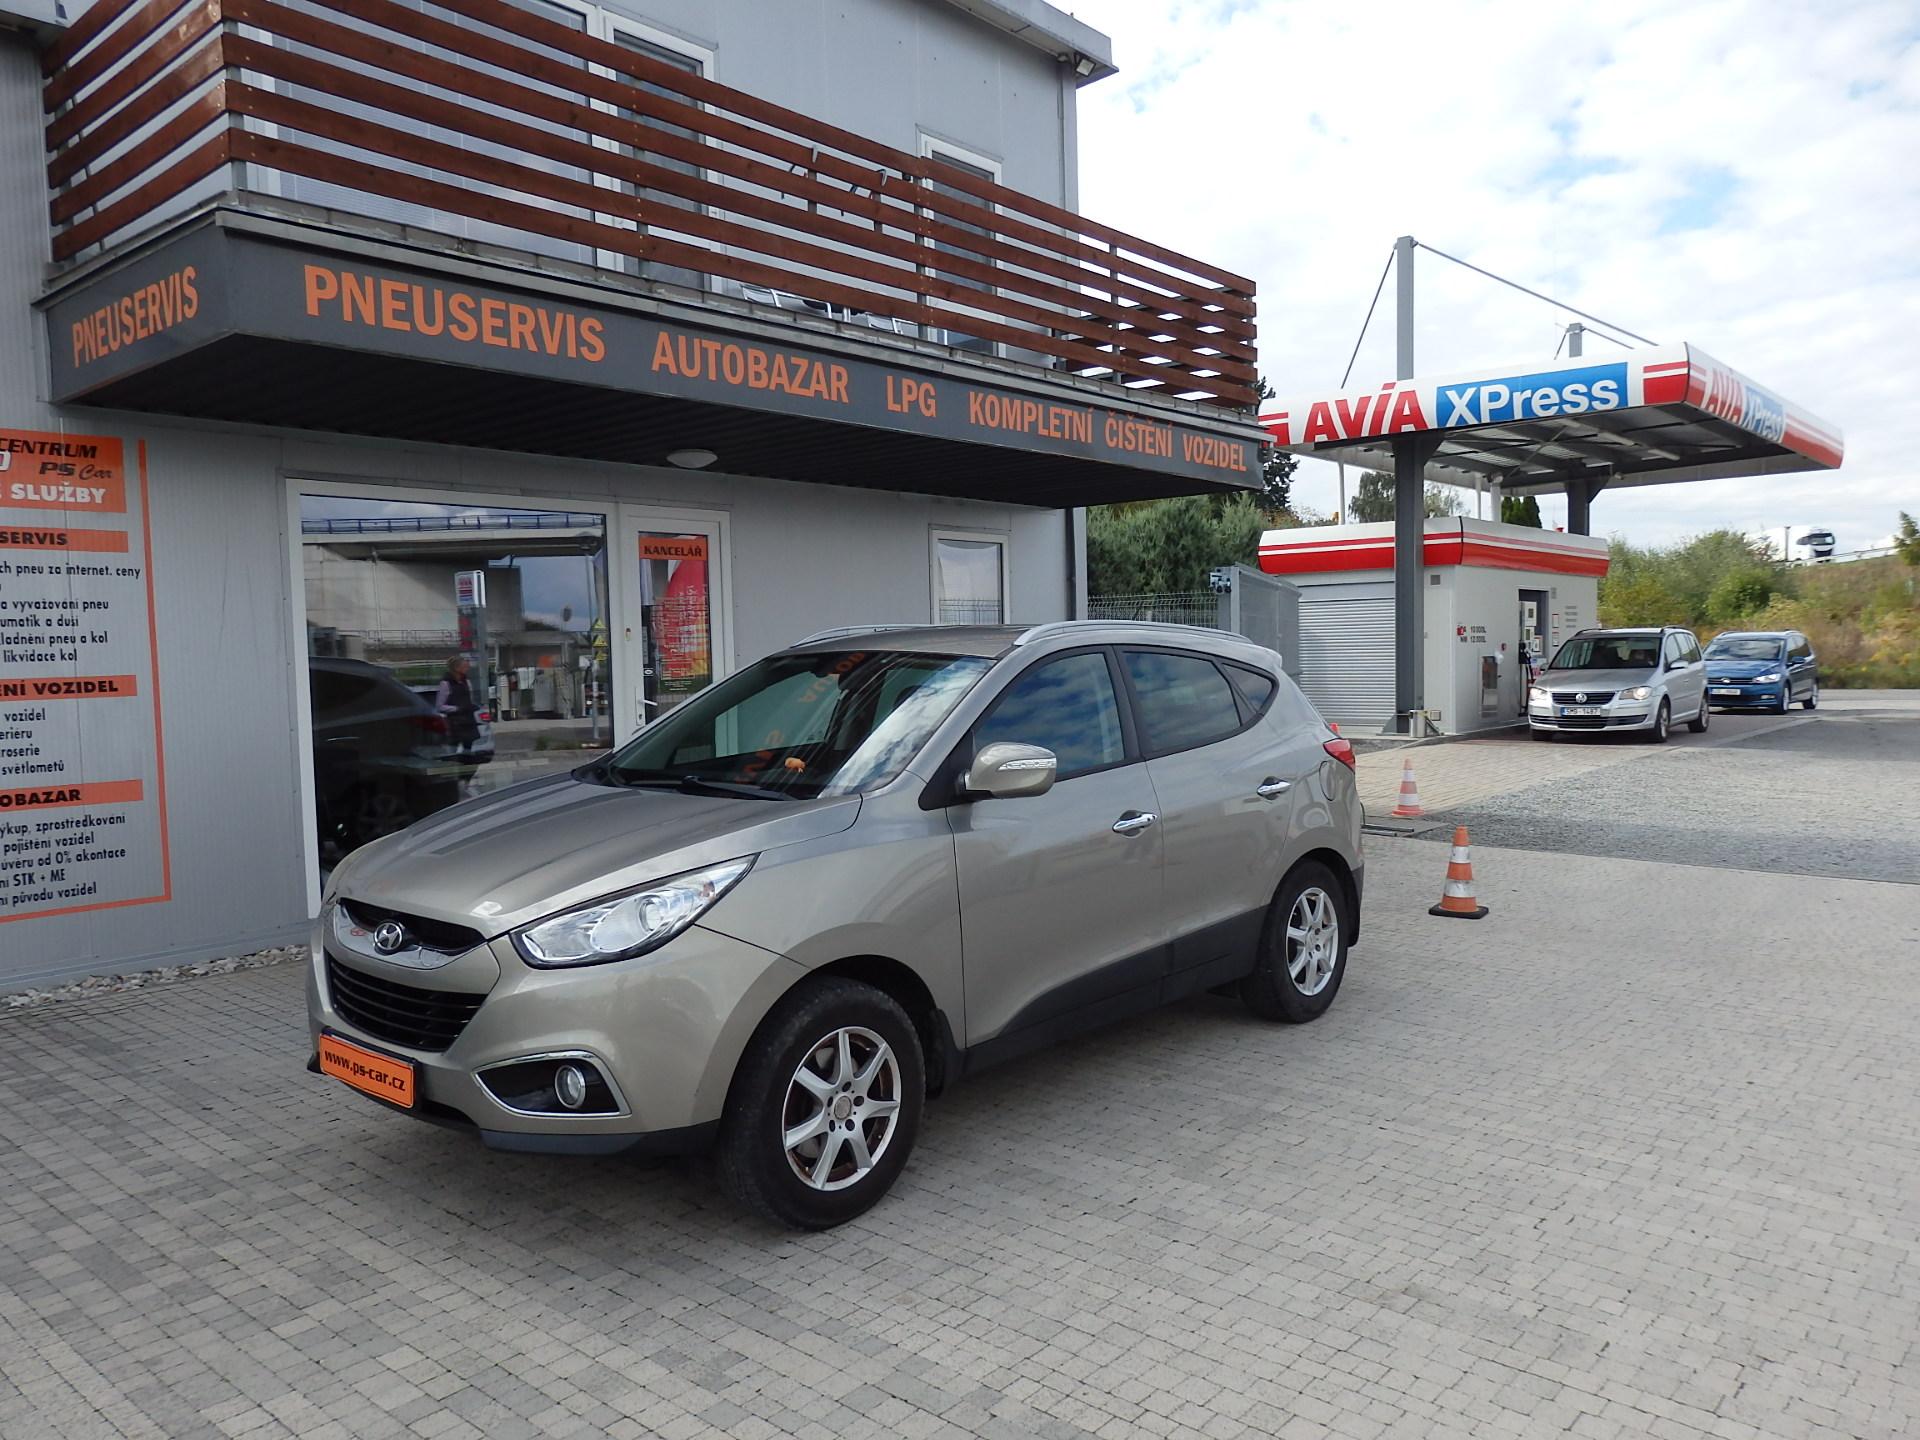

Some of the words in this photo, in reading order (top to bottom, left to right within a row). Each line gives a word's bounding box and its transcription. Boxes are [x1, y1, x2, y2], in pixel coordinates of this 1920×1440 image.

[72, 264, 199, 369] PNEUSERVIS
[303, 264, 607, 363] PNEUSERVIS
[651, 330, 850, 404] AUTOBAZAR
[886, 375, 937, 419] LPG
[968, 390, 1095, 444] KOMPLETNÍ
[1104, 409, 1174, 459] ČIŠTĚNÍ
[1182, 432, 1248, 472] VOZIDEL
[1445, 379, 1620, 428] XPress
[39, 462, 76, 476] PS
[11, 480, 106, 504] SLUŽBY
[0, 530, 69, 546] SERVIS
[643, 544, 703, 558] KANCELÁŘ
[16, 564, 44, 577] pneu
[48, 565, 61, 575] za
[65, 562, 113, 577] internet.
[116, 566, 141, 580] ceny
[1, 602, 8, 610] a
[12, 598, 79, 613] vyvažování
[82, 601, 110, 612] pneu
[45, 619, 52, 627] a
[0, 631, 45, 646] ladnění
[49, 634, 76, 647] pneu
[80, 636, 87, 644] a
[91, 630, 108, 644] kol
[3, 649, 56, 663] likvidace
[60, 648, 78, 662] kol
[33, 680, 119, 696] VOZIDEL
[4, 707, 46, 722] vozidel
[2, 760, 65, 776] světlometů
[0, 788, 81, 807] OBAZAR
[35, 812, 126, 835] zprostředkování
[3, 836, 51, 856] pojištění
[55, 831, 95, 848] vozidel
[38, 853, 51, 866] od
[55, 850, 72, 865] 0%
[75, 848, 126, 863] akontace
[13, 872, 36, 887] STK
[49, 868, 66, 883] ME
[12, 887, 54, 908] původu
[57, 881, 97, 899] vozidel
[324, 1050, 406, 1092] www.ps-car.cz
